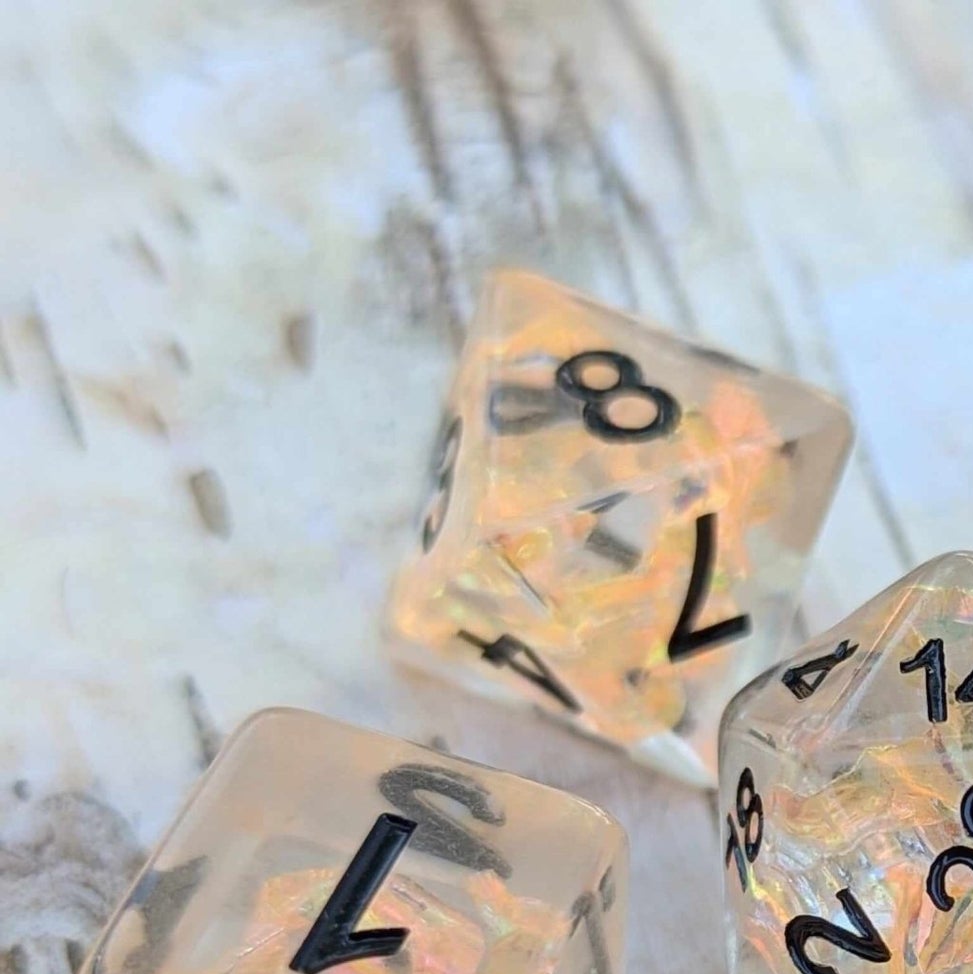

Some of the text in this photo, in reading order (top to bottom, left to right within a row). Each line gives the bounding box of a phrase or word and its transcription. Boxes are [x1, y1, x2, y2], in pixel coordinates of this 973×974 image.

[554, 350, 682, 444] 8
[668, 512, 751, 663] 7
[457, 629, 582, 712] 4
[782, 639, 859, 701] 4
